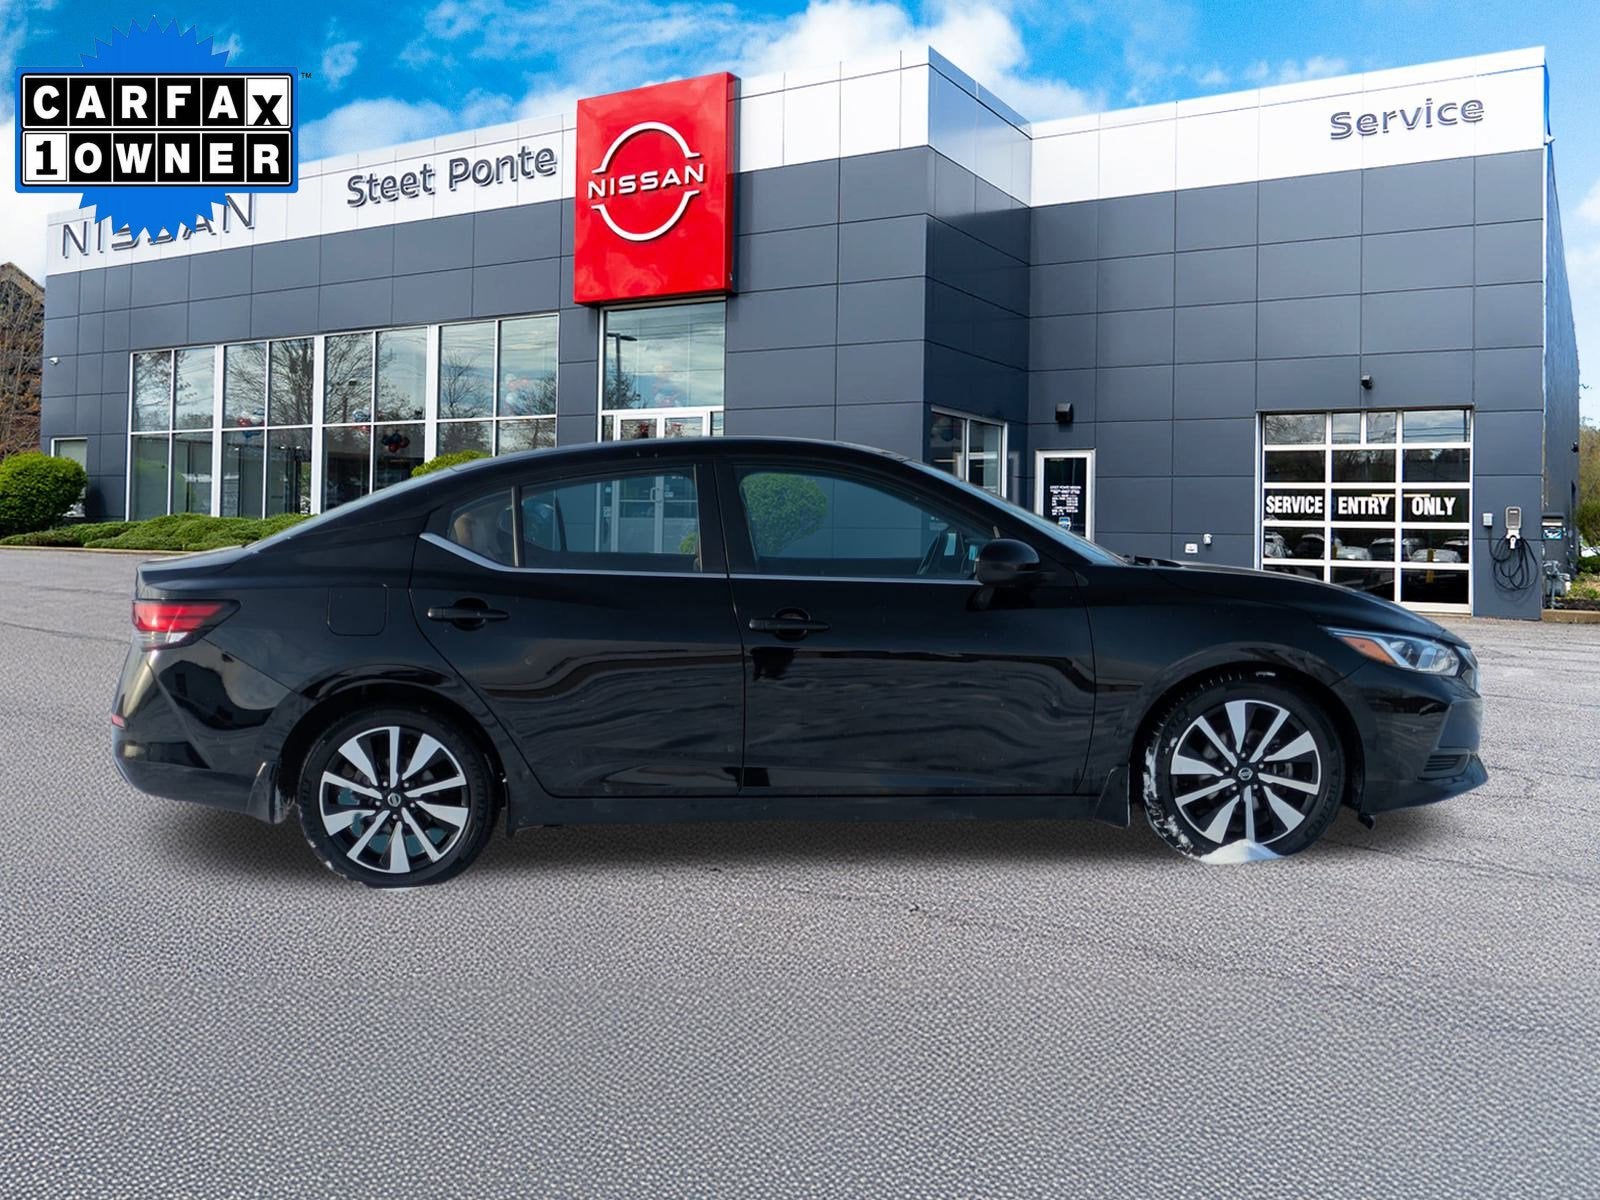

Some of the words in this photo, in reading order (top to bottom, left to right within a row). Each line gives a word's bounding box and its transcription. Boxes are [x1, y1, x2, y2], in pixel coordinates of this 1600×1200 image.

[1330, 98, 1485, 140] Service
[347, 163, 435, 207] Steet
[448, 146, 557, 191] Ponte
[587, 163, 705, 200] NISSAN
[1265, 495, 1323, 515] SERVICE
[1338, 496, 1390, 516] ENTRY
[1411, 496, 1456, 516] ONLY
